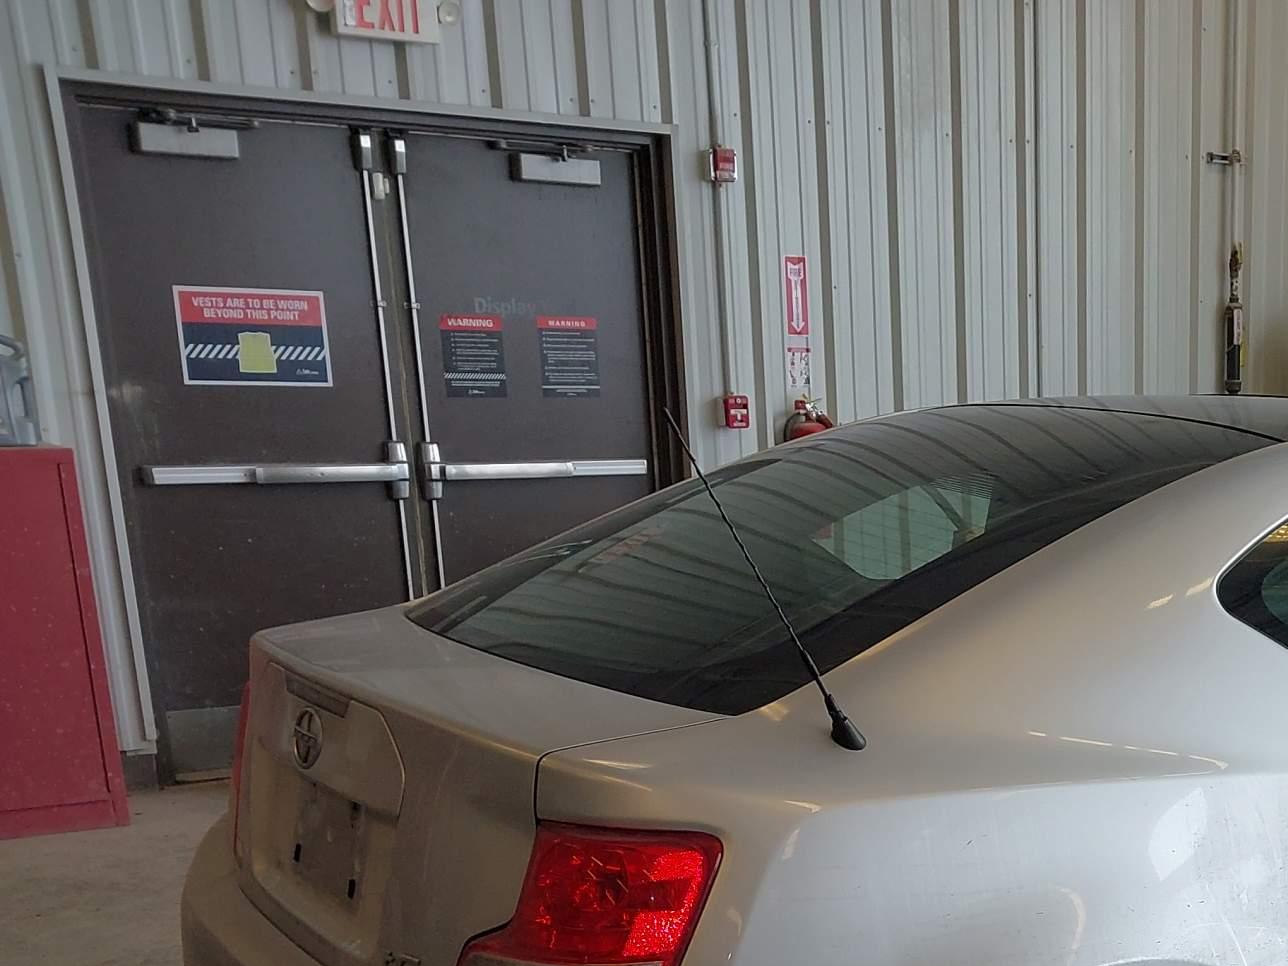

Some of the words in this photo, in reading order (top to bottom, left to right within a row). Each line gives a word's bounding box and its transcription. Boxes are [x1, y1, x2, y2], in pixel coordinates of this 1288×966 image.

[192, 297, 224, 307] VESTS
[226, 298, 246, 309] ARE
[248, 299, 262, 309] TO
[263, 300, 275, 310] BE
[277, 301, 308, 311] WORN
[474, 296, 537, 319] Display
[203, 308, 244, 318] BEYOND
[247, 310, 269, 319] THIS
[271, 311, 300, 321] POINT
[447, 317, 494, 328] WARNING
[548, 320, 586, 328] WARNING
